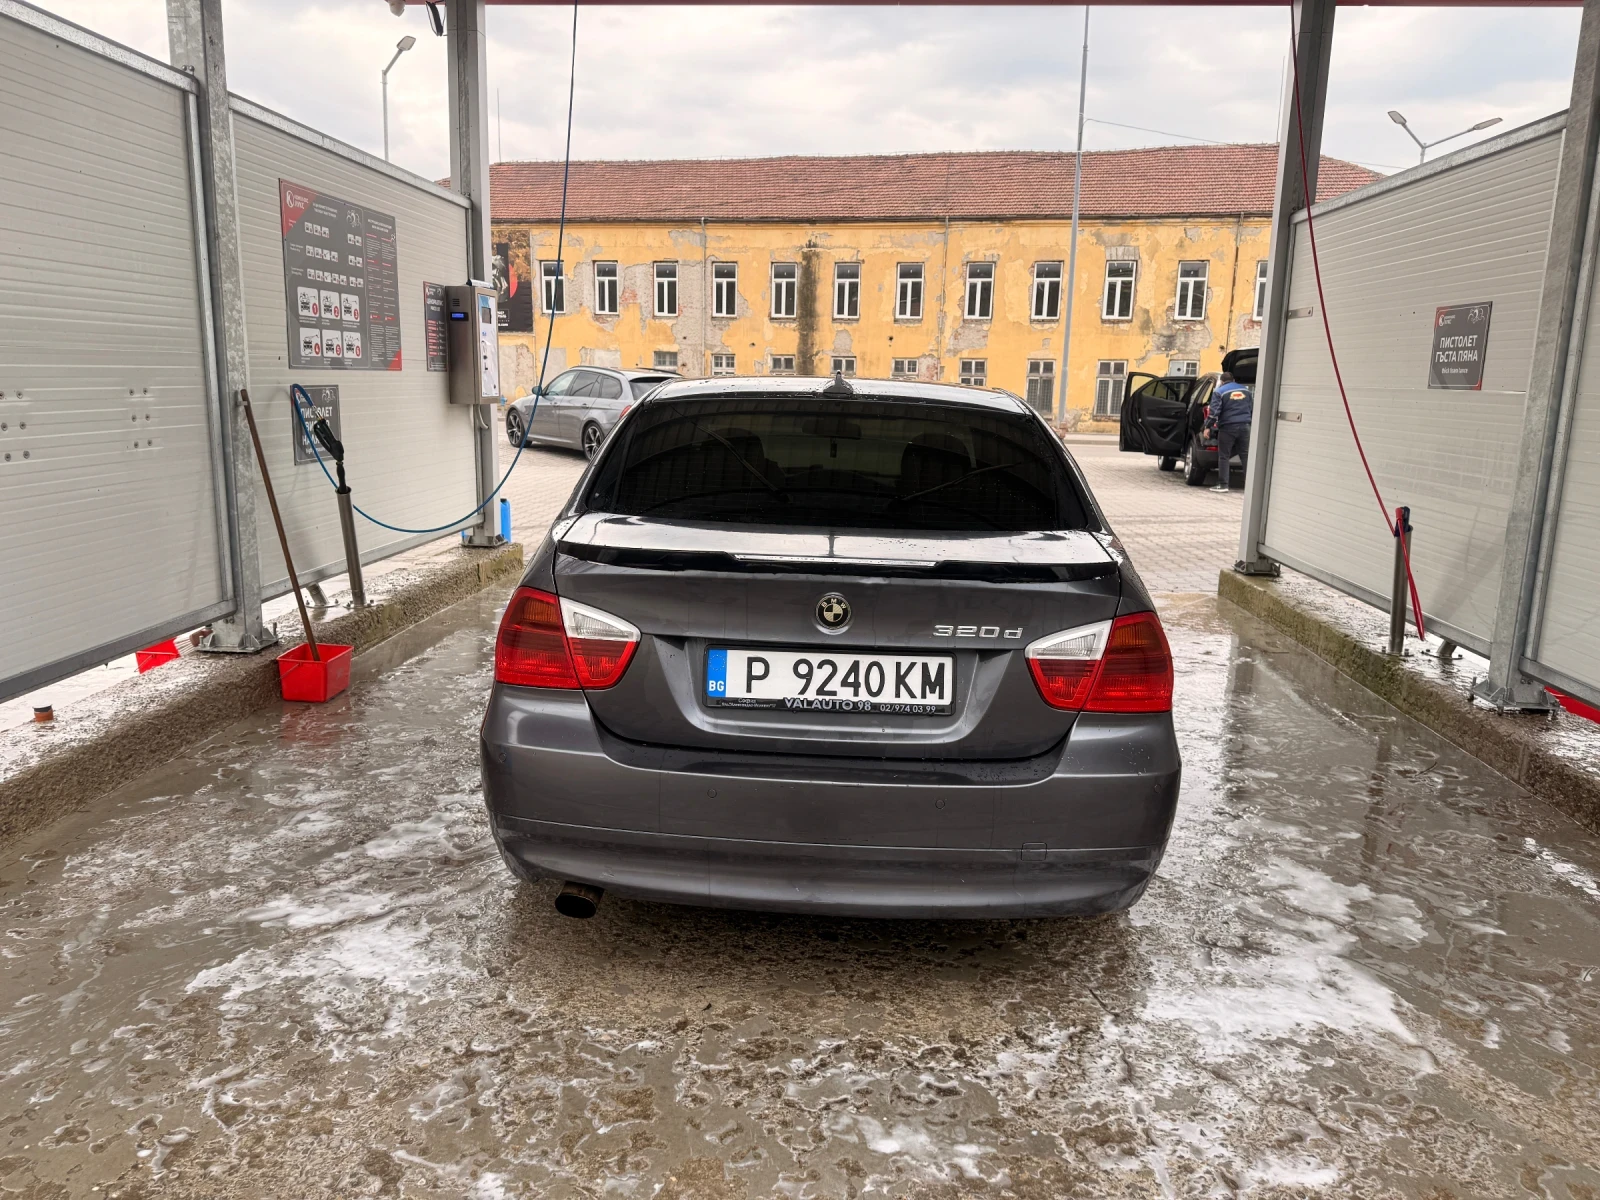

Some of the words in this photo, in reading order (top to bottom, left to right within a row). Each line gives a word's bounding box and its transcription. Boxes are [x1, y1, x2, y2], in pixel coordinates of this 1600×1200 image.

[1440, 334, 1478, 348] ПИСТОЛЕТ
[1435, 351, 1456, 362] ГЪСТА
[1458, 350, 1478, 362] ПЯНА
[301, 407, 332, 418] ПИСОЛЕТ
[821, 598, 846, 608] BMW
[933, 625, 1023, 638] 320d
[746, 656, 770, 694] P
[793, 658, 885, 698] 9240
[895, 662, 945, 700] KM
[708, 680, 724, 691] BG
[783, 697, 853, 711] VALAUTO
[857, 700, 872, 711] 98
[880, 704, 910, 713] 02/974
[912, 705, 923, 713] 03
[925, 705, 936, 714] 99
